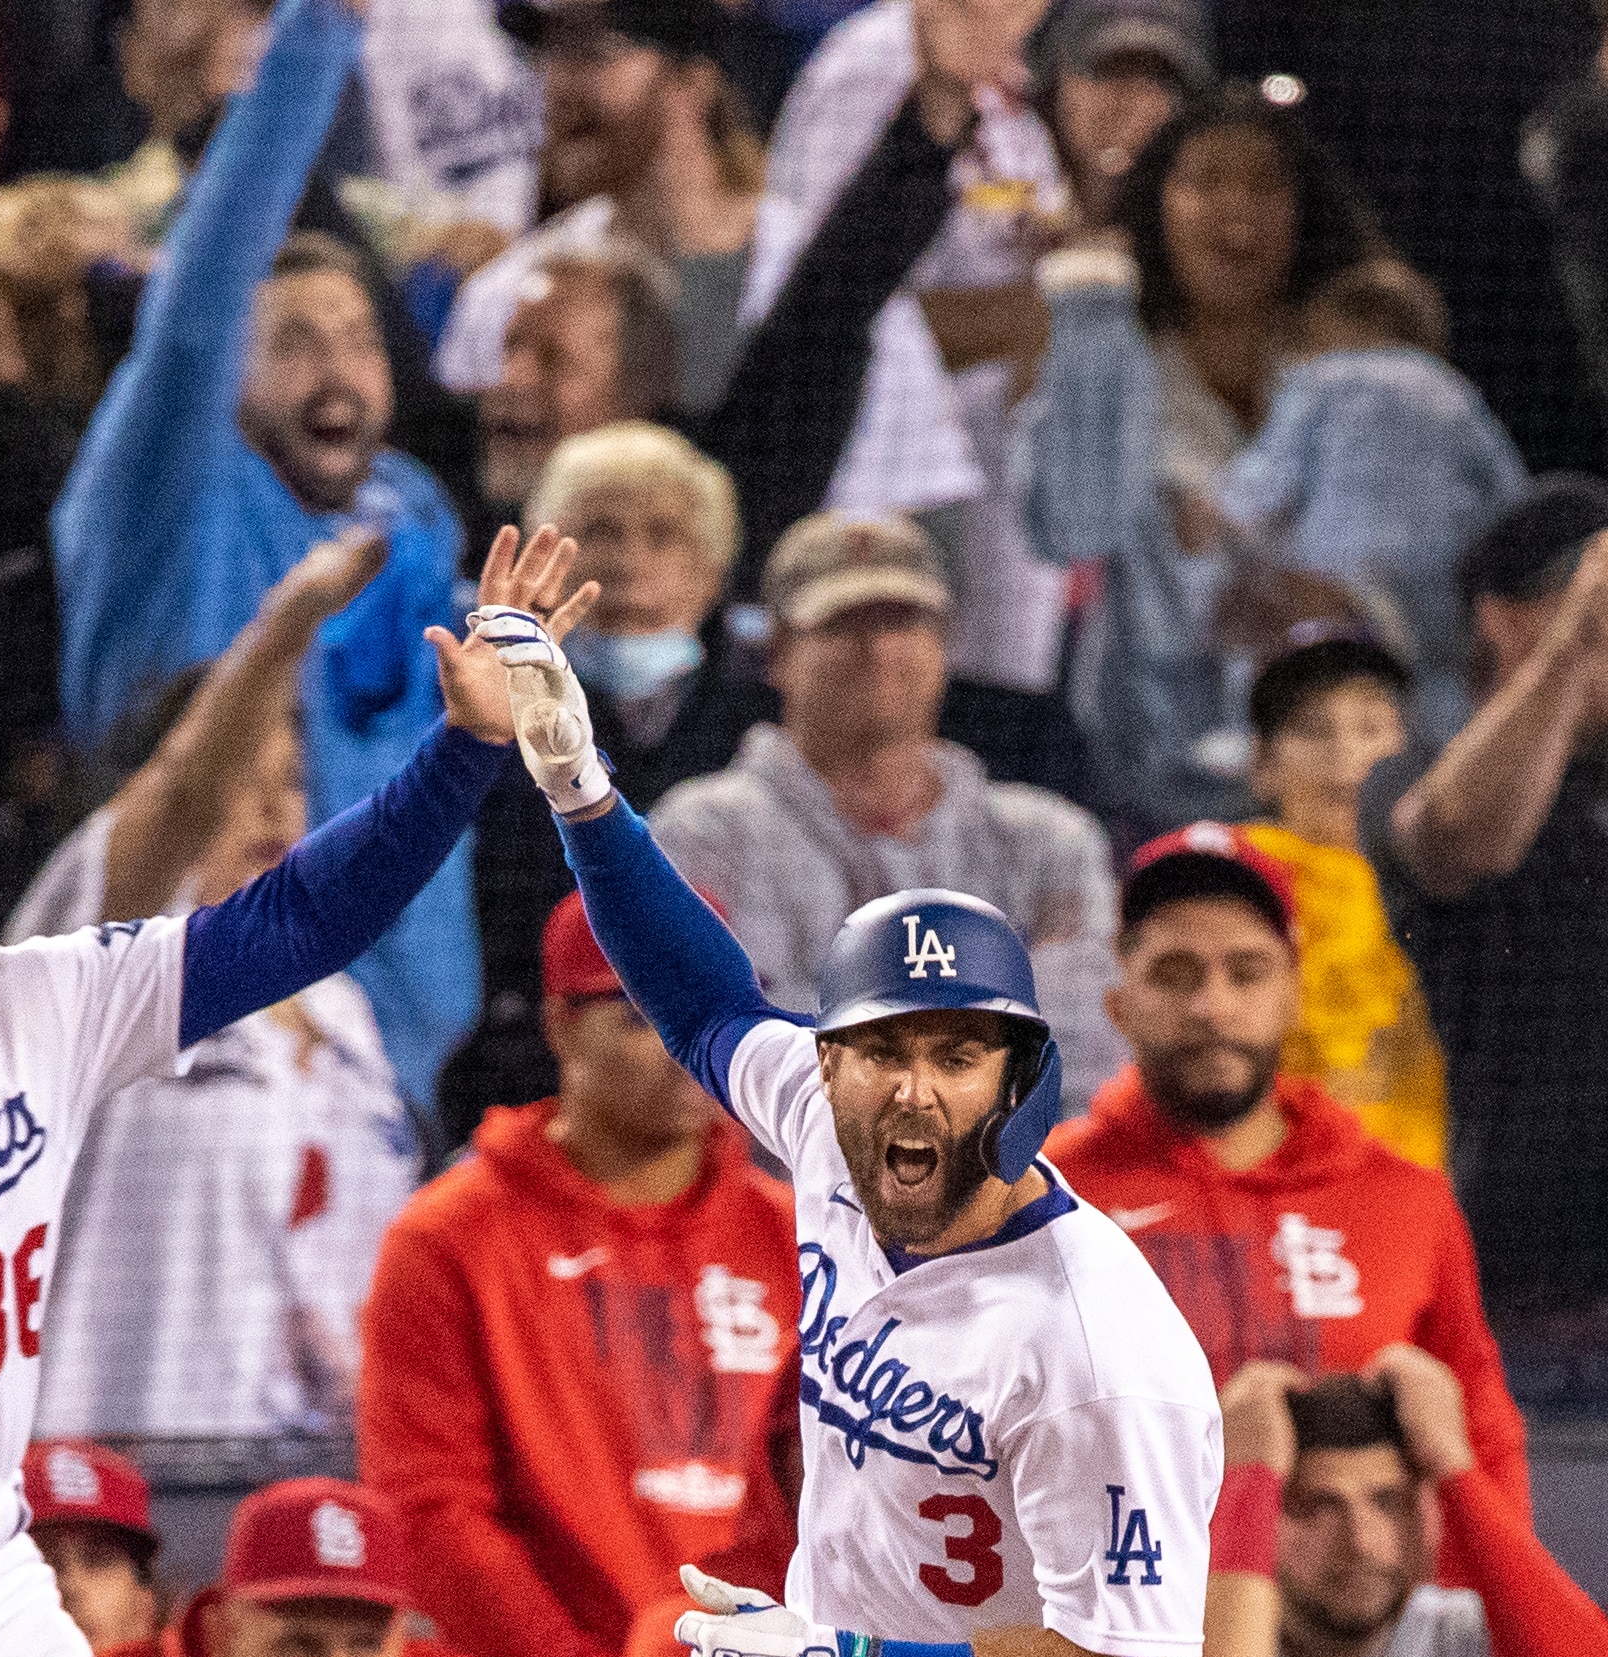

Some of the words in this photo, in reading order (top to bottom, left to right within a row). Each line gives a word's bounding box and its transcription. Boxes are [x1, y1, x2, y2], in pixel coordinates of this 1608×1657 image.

[901, 915, 958, 980] LA
[918, 1494, 1004, 1607] 3
[1105, 1484, 1163, 1586] LA
